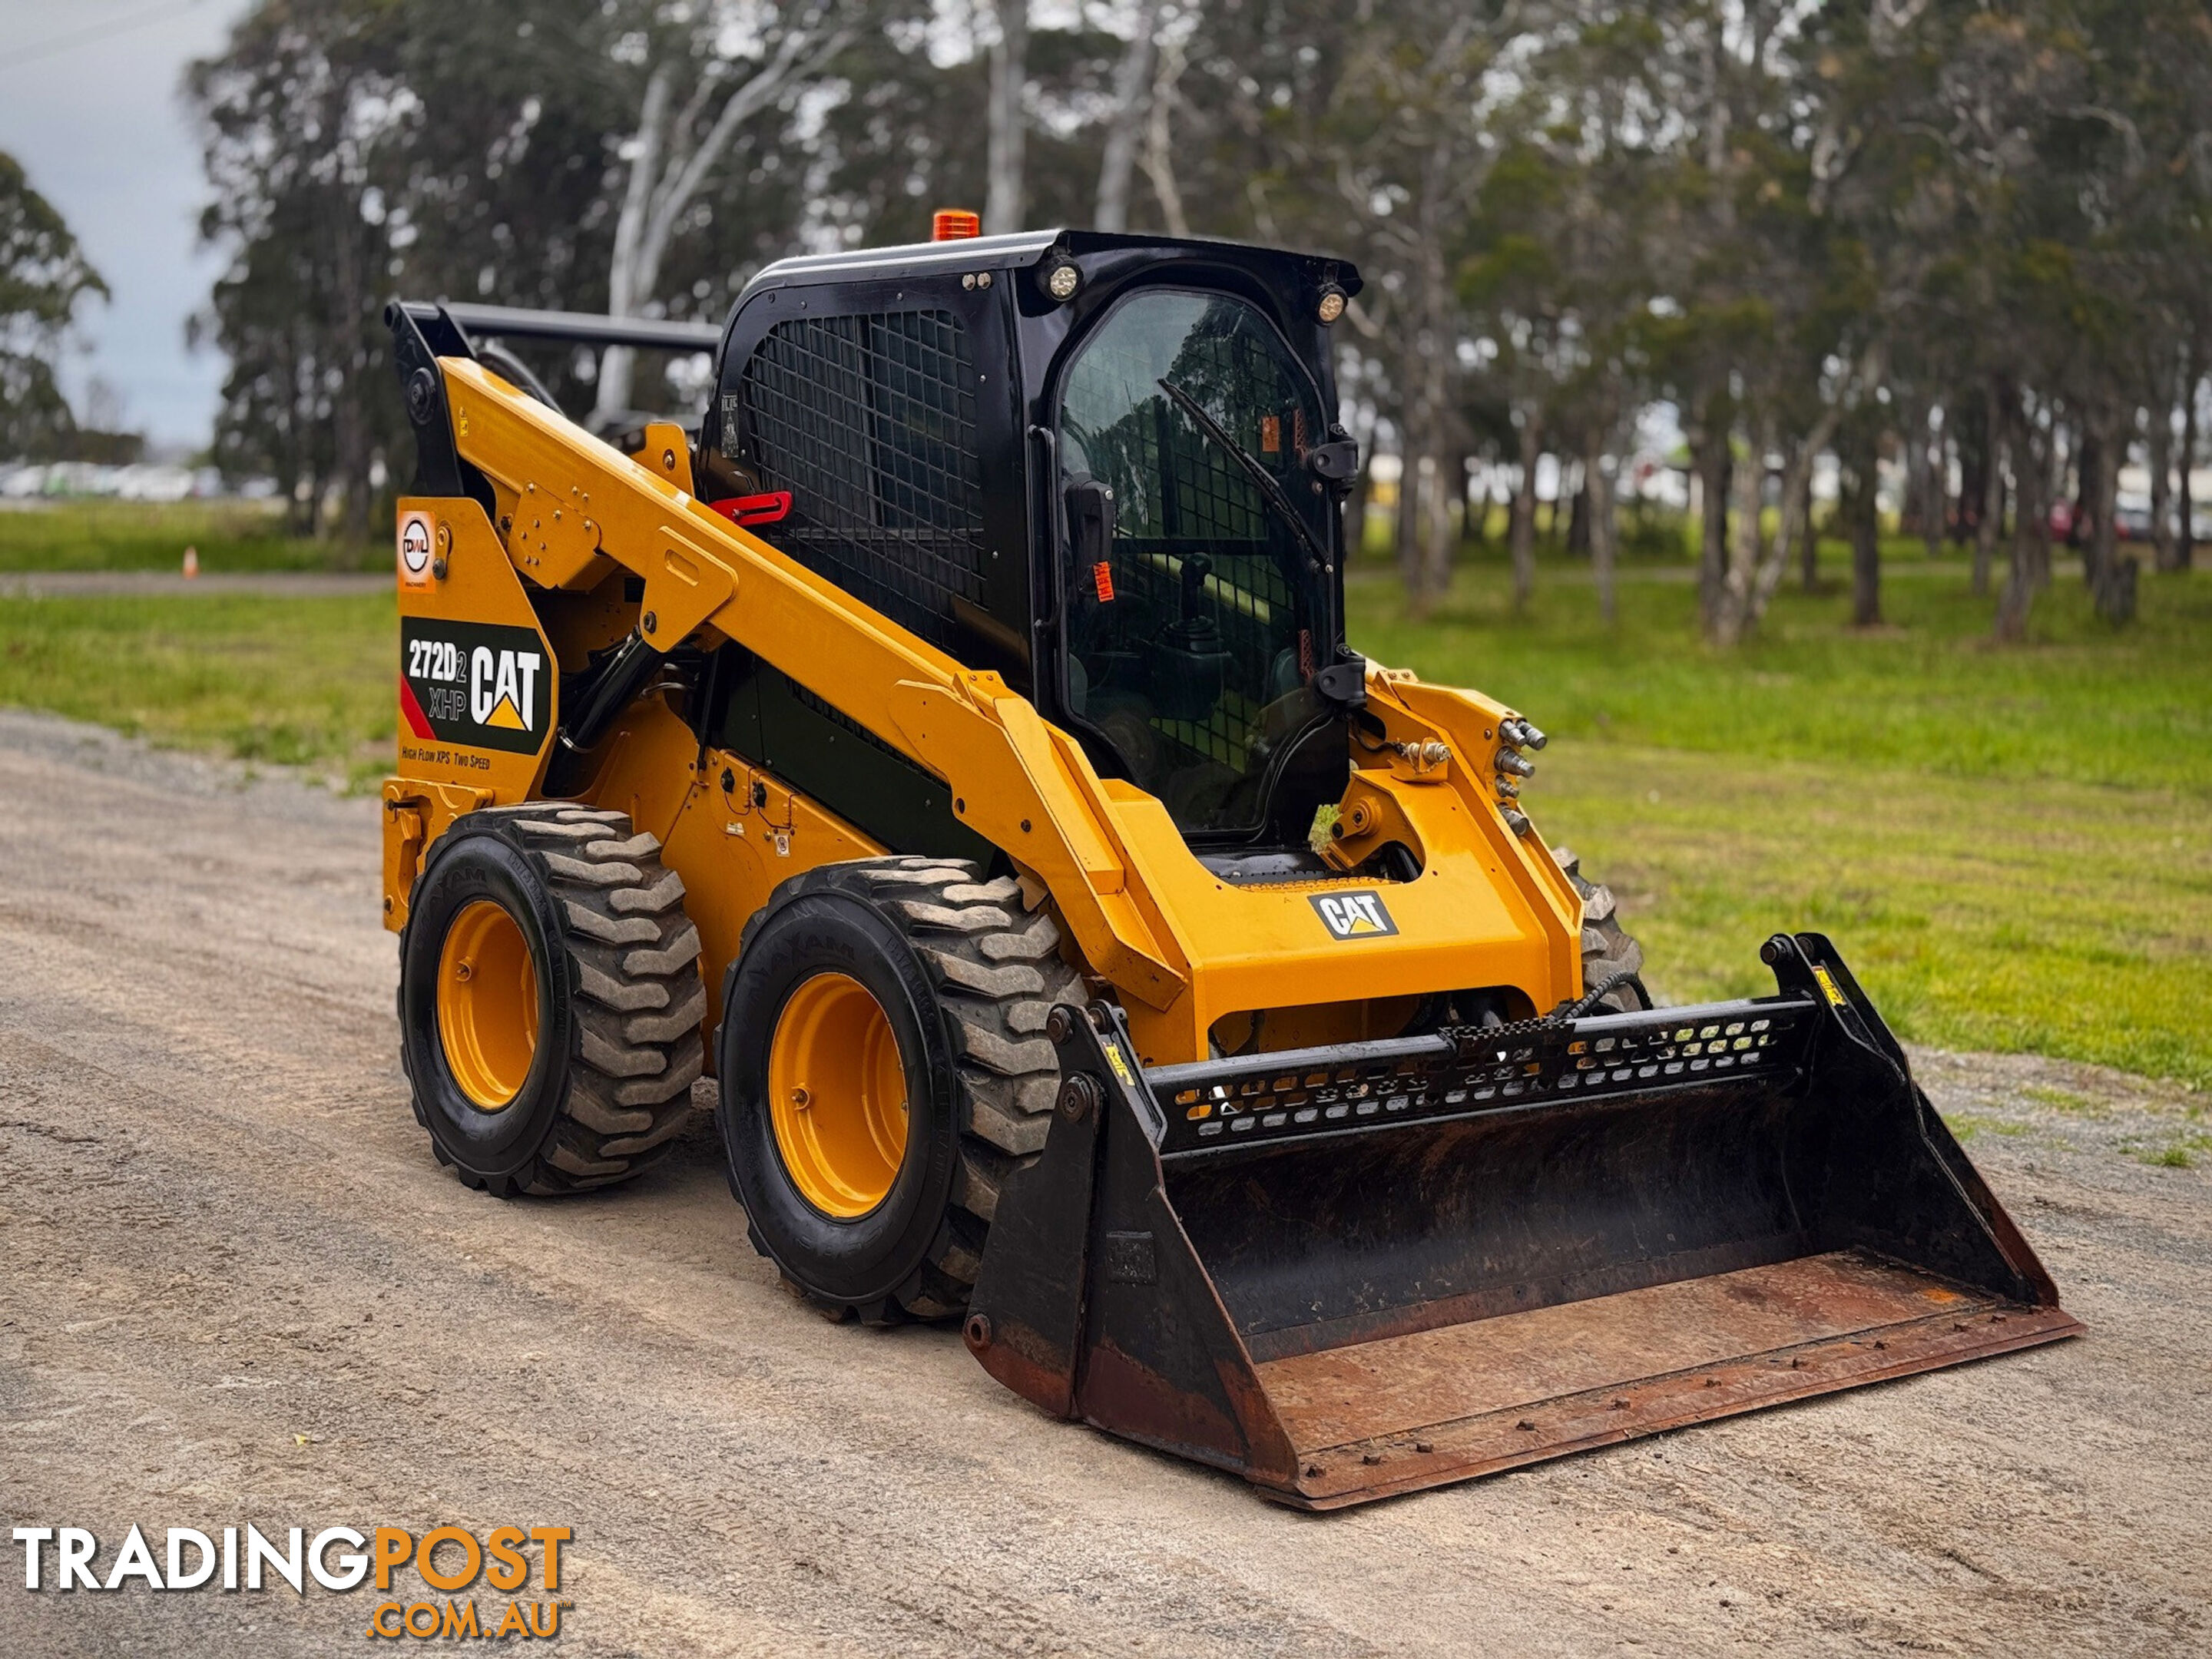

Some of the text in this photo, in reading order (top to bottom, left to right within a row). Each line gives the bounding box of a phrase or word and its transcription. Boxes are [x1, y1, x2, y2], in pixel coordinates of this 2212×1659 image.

[429, 687, 466, 720] XHP
[471, 646, 540, 731] CAT
[436, 750, 450, 765] XPS
[1320, 895, 1388, 935] CAT
